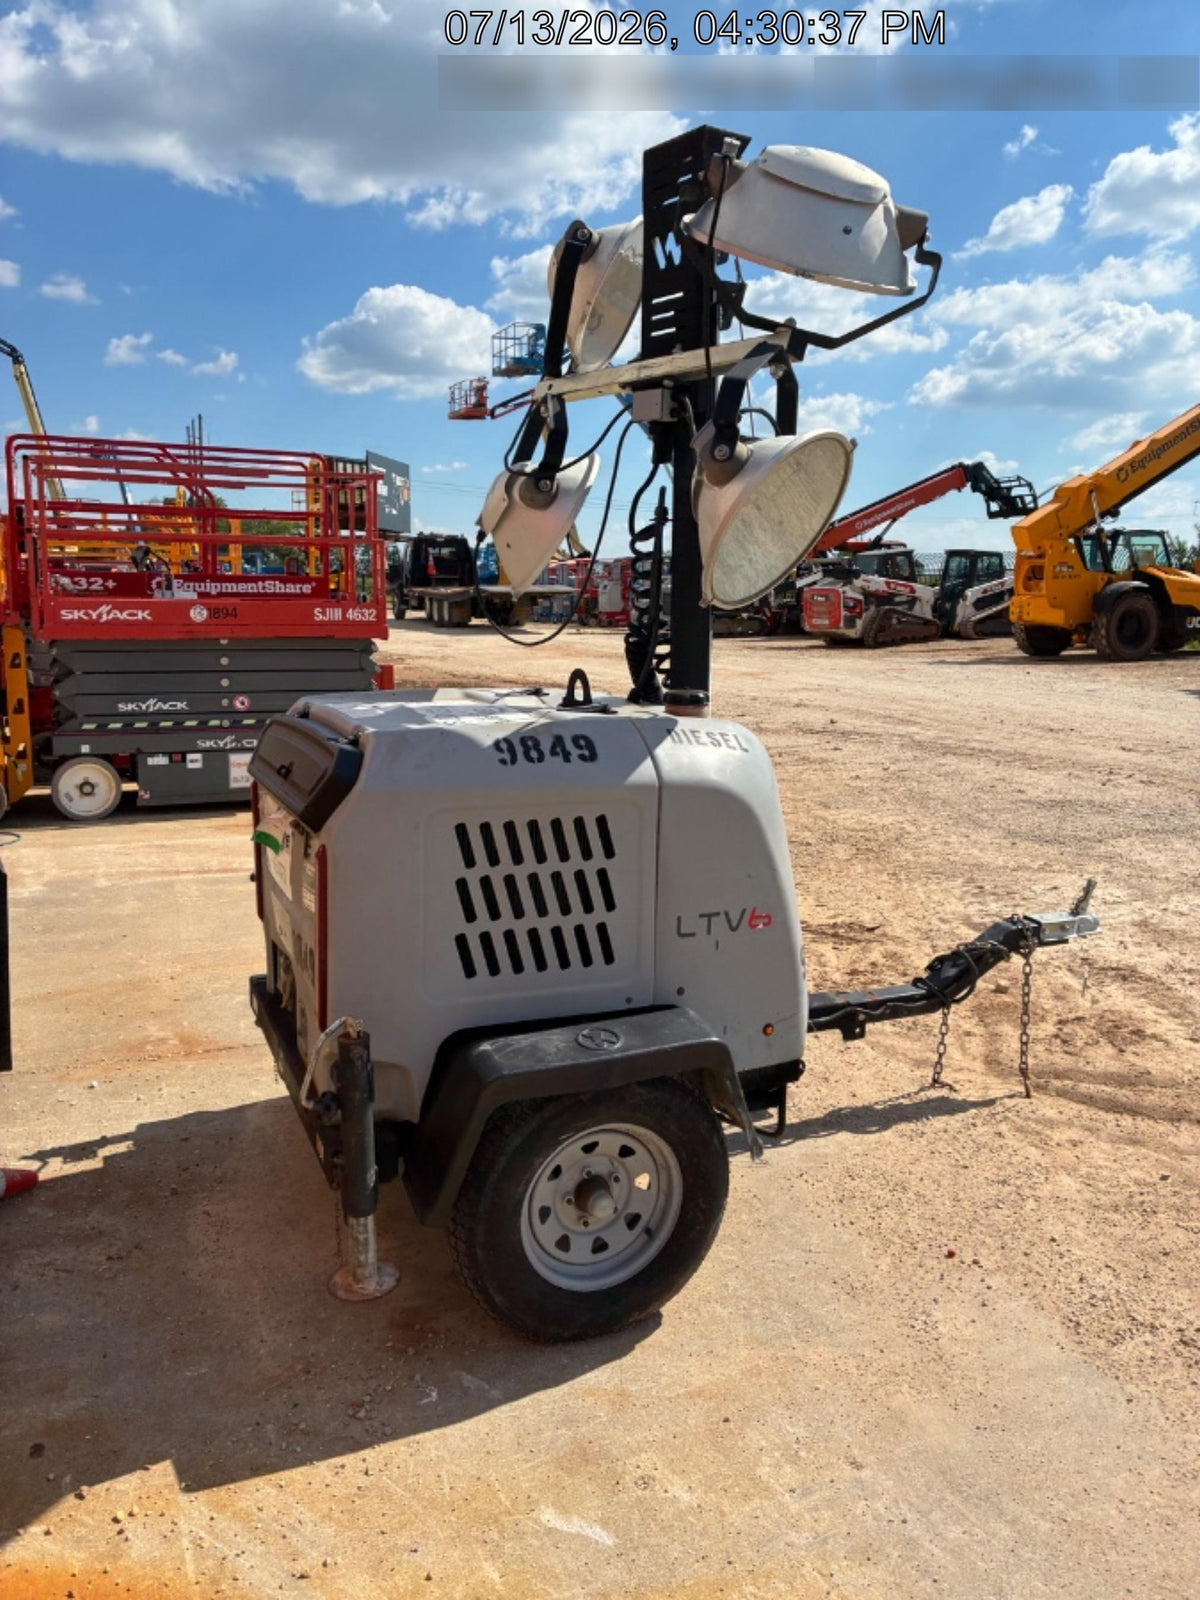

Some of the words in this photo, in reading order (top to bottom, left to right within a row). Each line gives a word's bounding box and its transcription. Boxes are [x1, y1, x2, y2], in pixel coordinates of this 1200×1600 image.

[60, 604, 152, 622] SKYJACK
[207, 607, 238, 620] 1894
[346, 608, 377, 621] 4632
[117, 698, 189, 712] SKYJACK
[494, 733, 599, 766] 9849
[666, 728, 750, 753] DIESEL
[676, 906, 772, 938] LTV6
